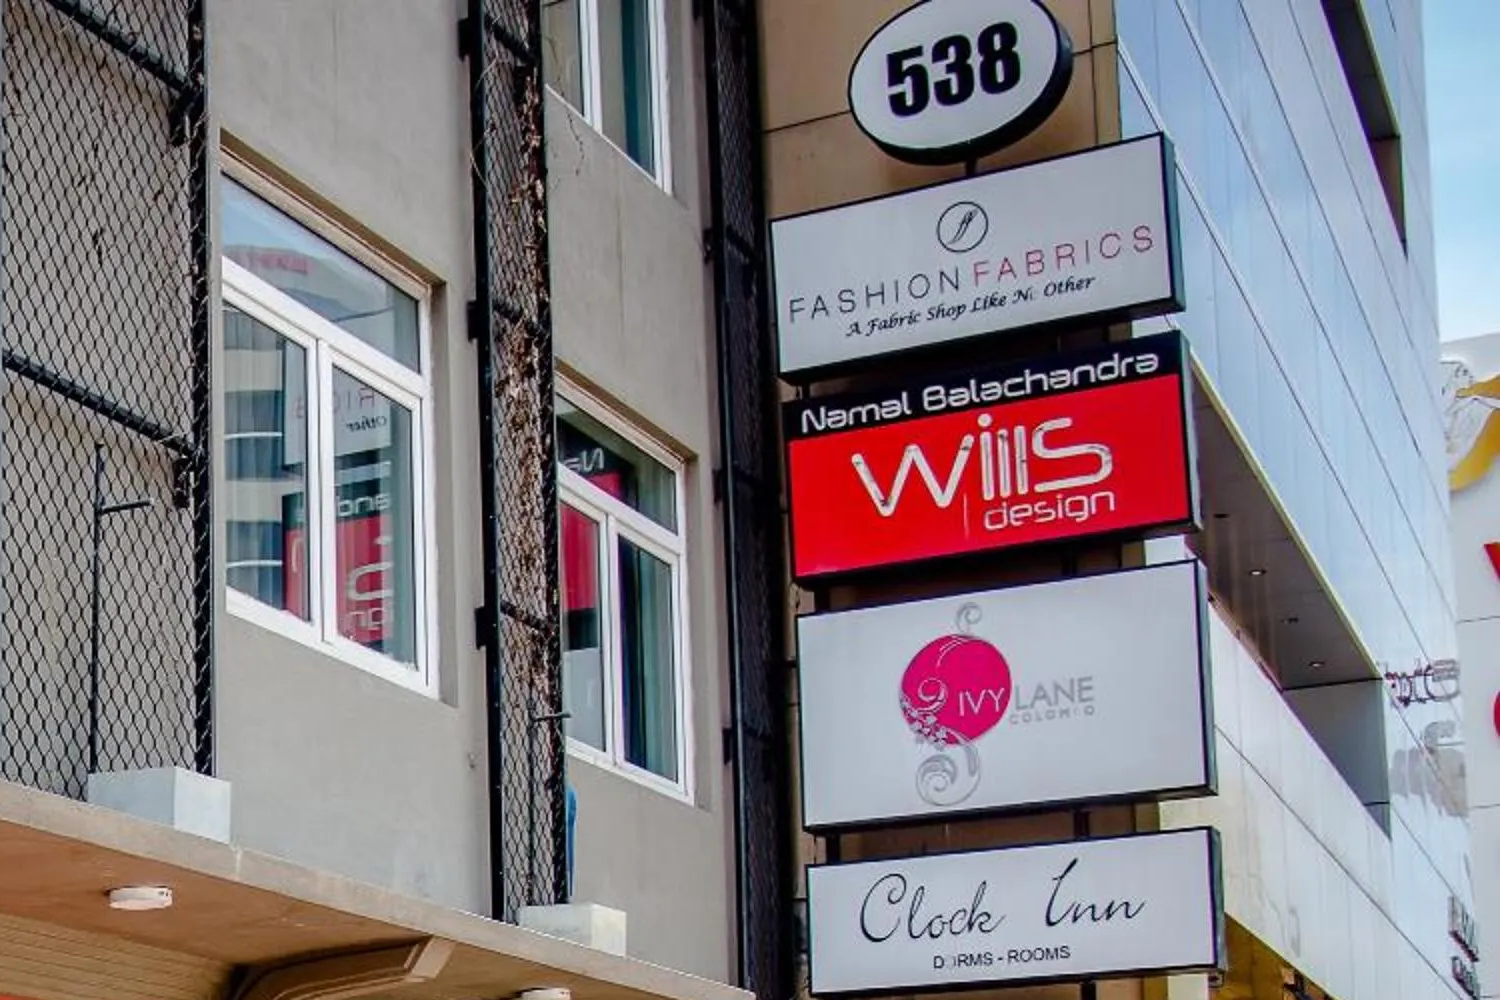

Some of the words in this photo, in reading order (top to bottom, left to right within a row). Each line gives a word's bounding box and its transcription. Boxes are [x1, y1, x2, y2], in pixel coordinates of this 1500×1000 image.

[886, 21, 1022, 118] 538
[790, 267, 960, 323] FASHION
[973, 225, 1154, 287] FABRICS
[846, 322, 862, 337] A
[866, 312, 921, 337] Fabric
[926, 303, 966, 321] Shop
[971, 295, 1007, 312] Like
[1044, 275, 1096, 298] Other
[801, 391, 912, 434] Namal
[923, 351, 1159, 412] Balachandra
[984, 488, 1116, 532] design
[958, 687, 1006, 718] IVY
[1014, 676, 1094, 711] LANE
[860, 871, 1007, 943] Clock
[1045, 857, 1147, 928] Inn
[933, 952, 993, 969] DRMS
[1008, 945, 1071, 964] ROOMS
